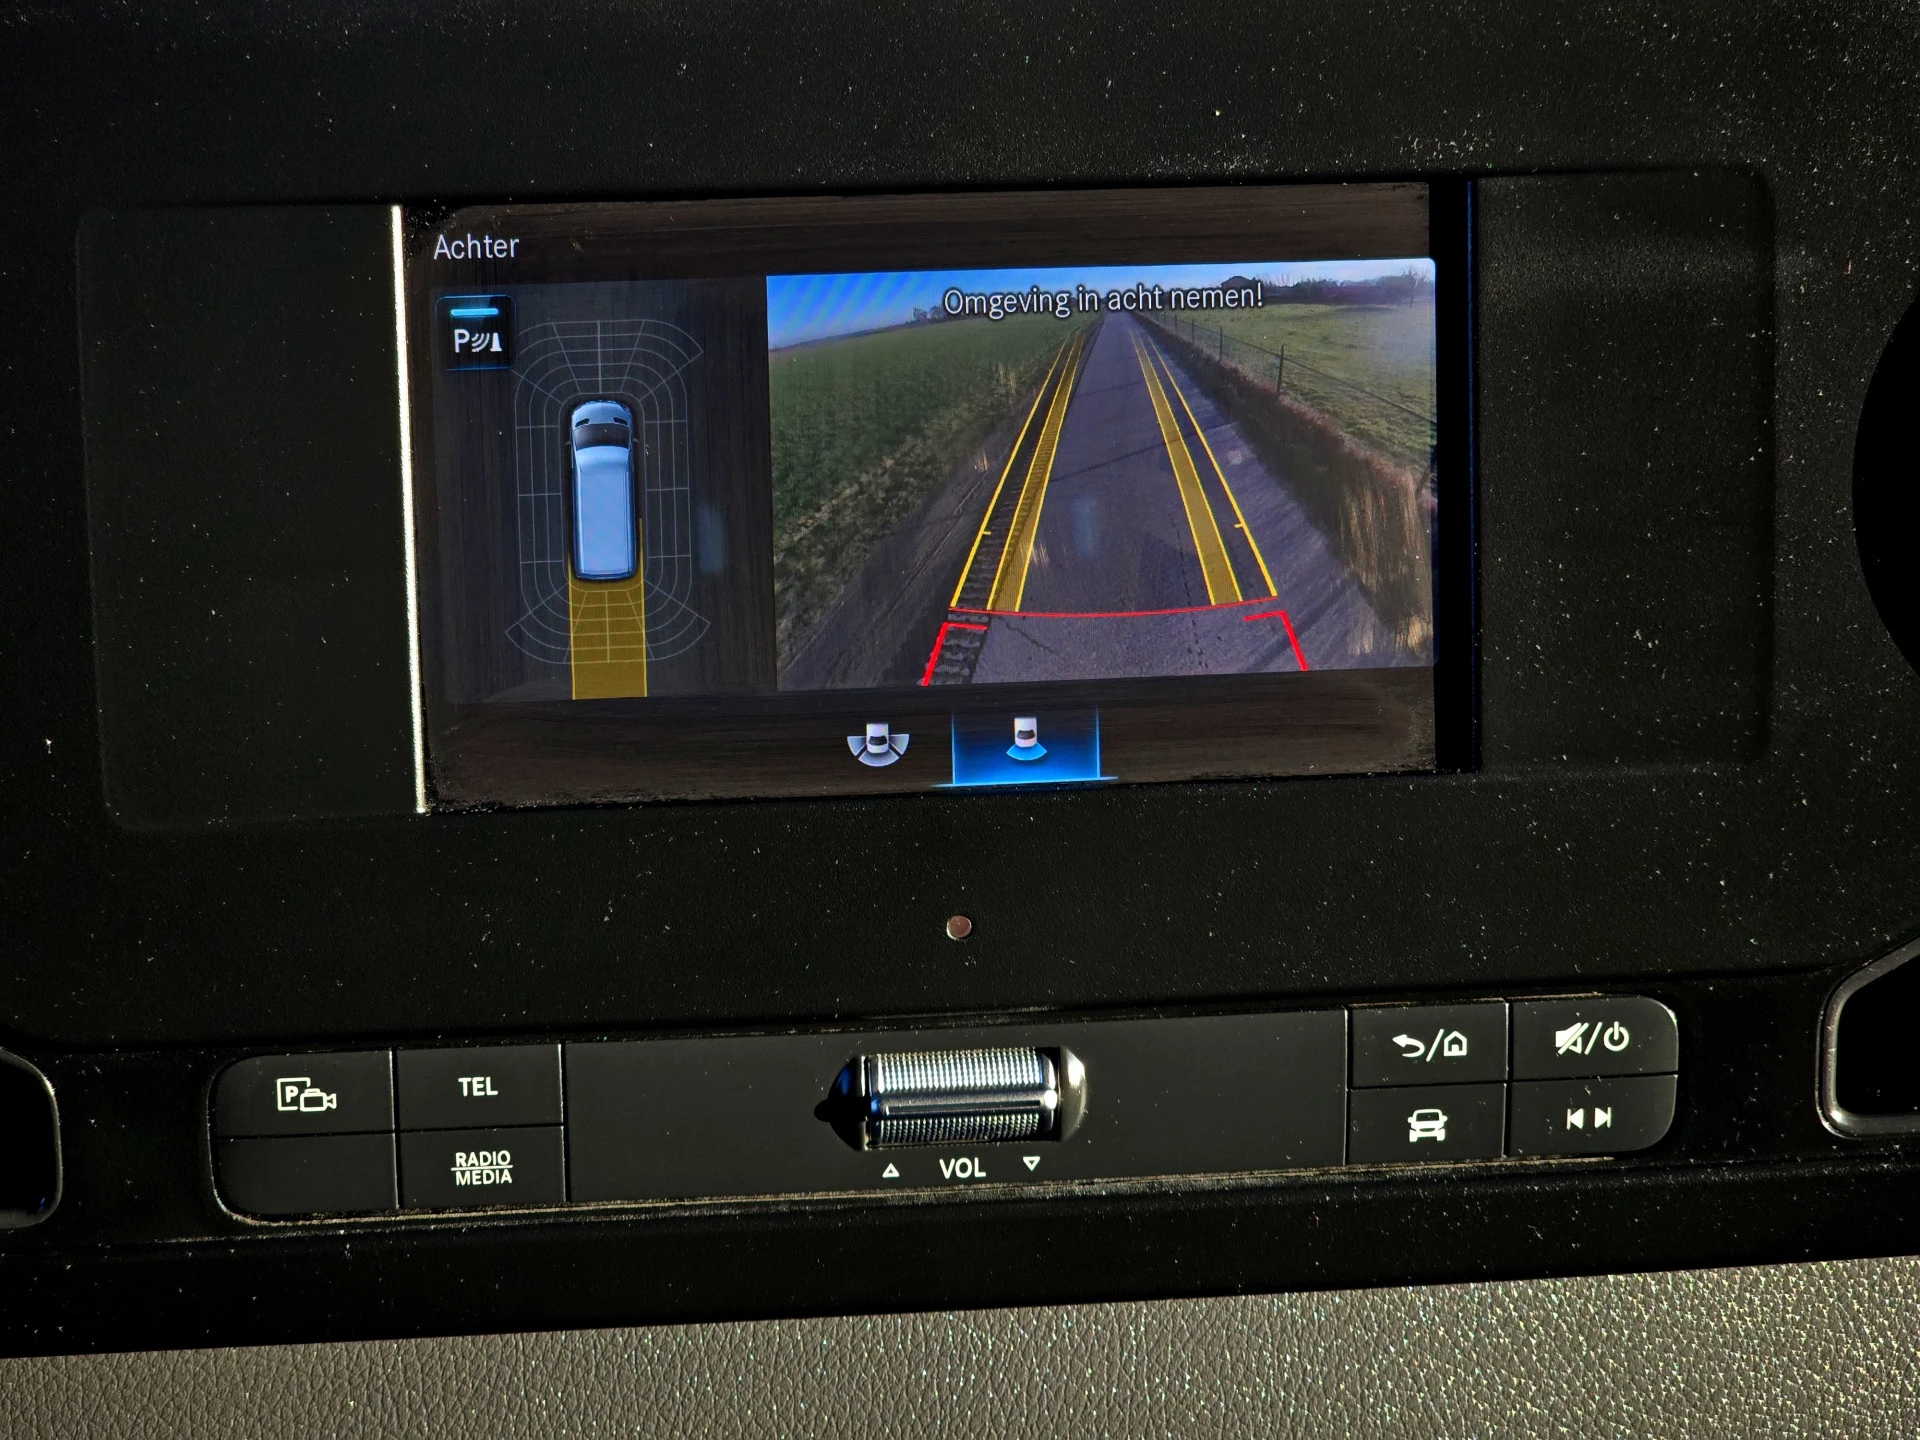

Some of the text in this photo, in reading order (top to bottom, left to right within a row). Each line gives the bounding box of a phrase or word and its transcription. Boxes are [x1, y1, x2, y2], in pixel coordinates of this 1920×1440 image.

[433, 233, 520, 260] Achter
[944, 283, 1264, 319] Omgeving in acht nemen!
[453, 328, 470, 353] P
[285, 1085, 299, 1103] P
[458, 1076, 499, 1097] TEL
[455, 1150, 511, 1167] RADIO
[939, 1157, 987, 1179] VOL
[455, 1168, 513, 1186] MEDIA
